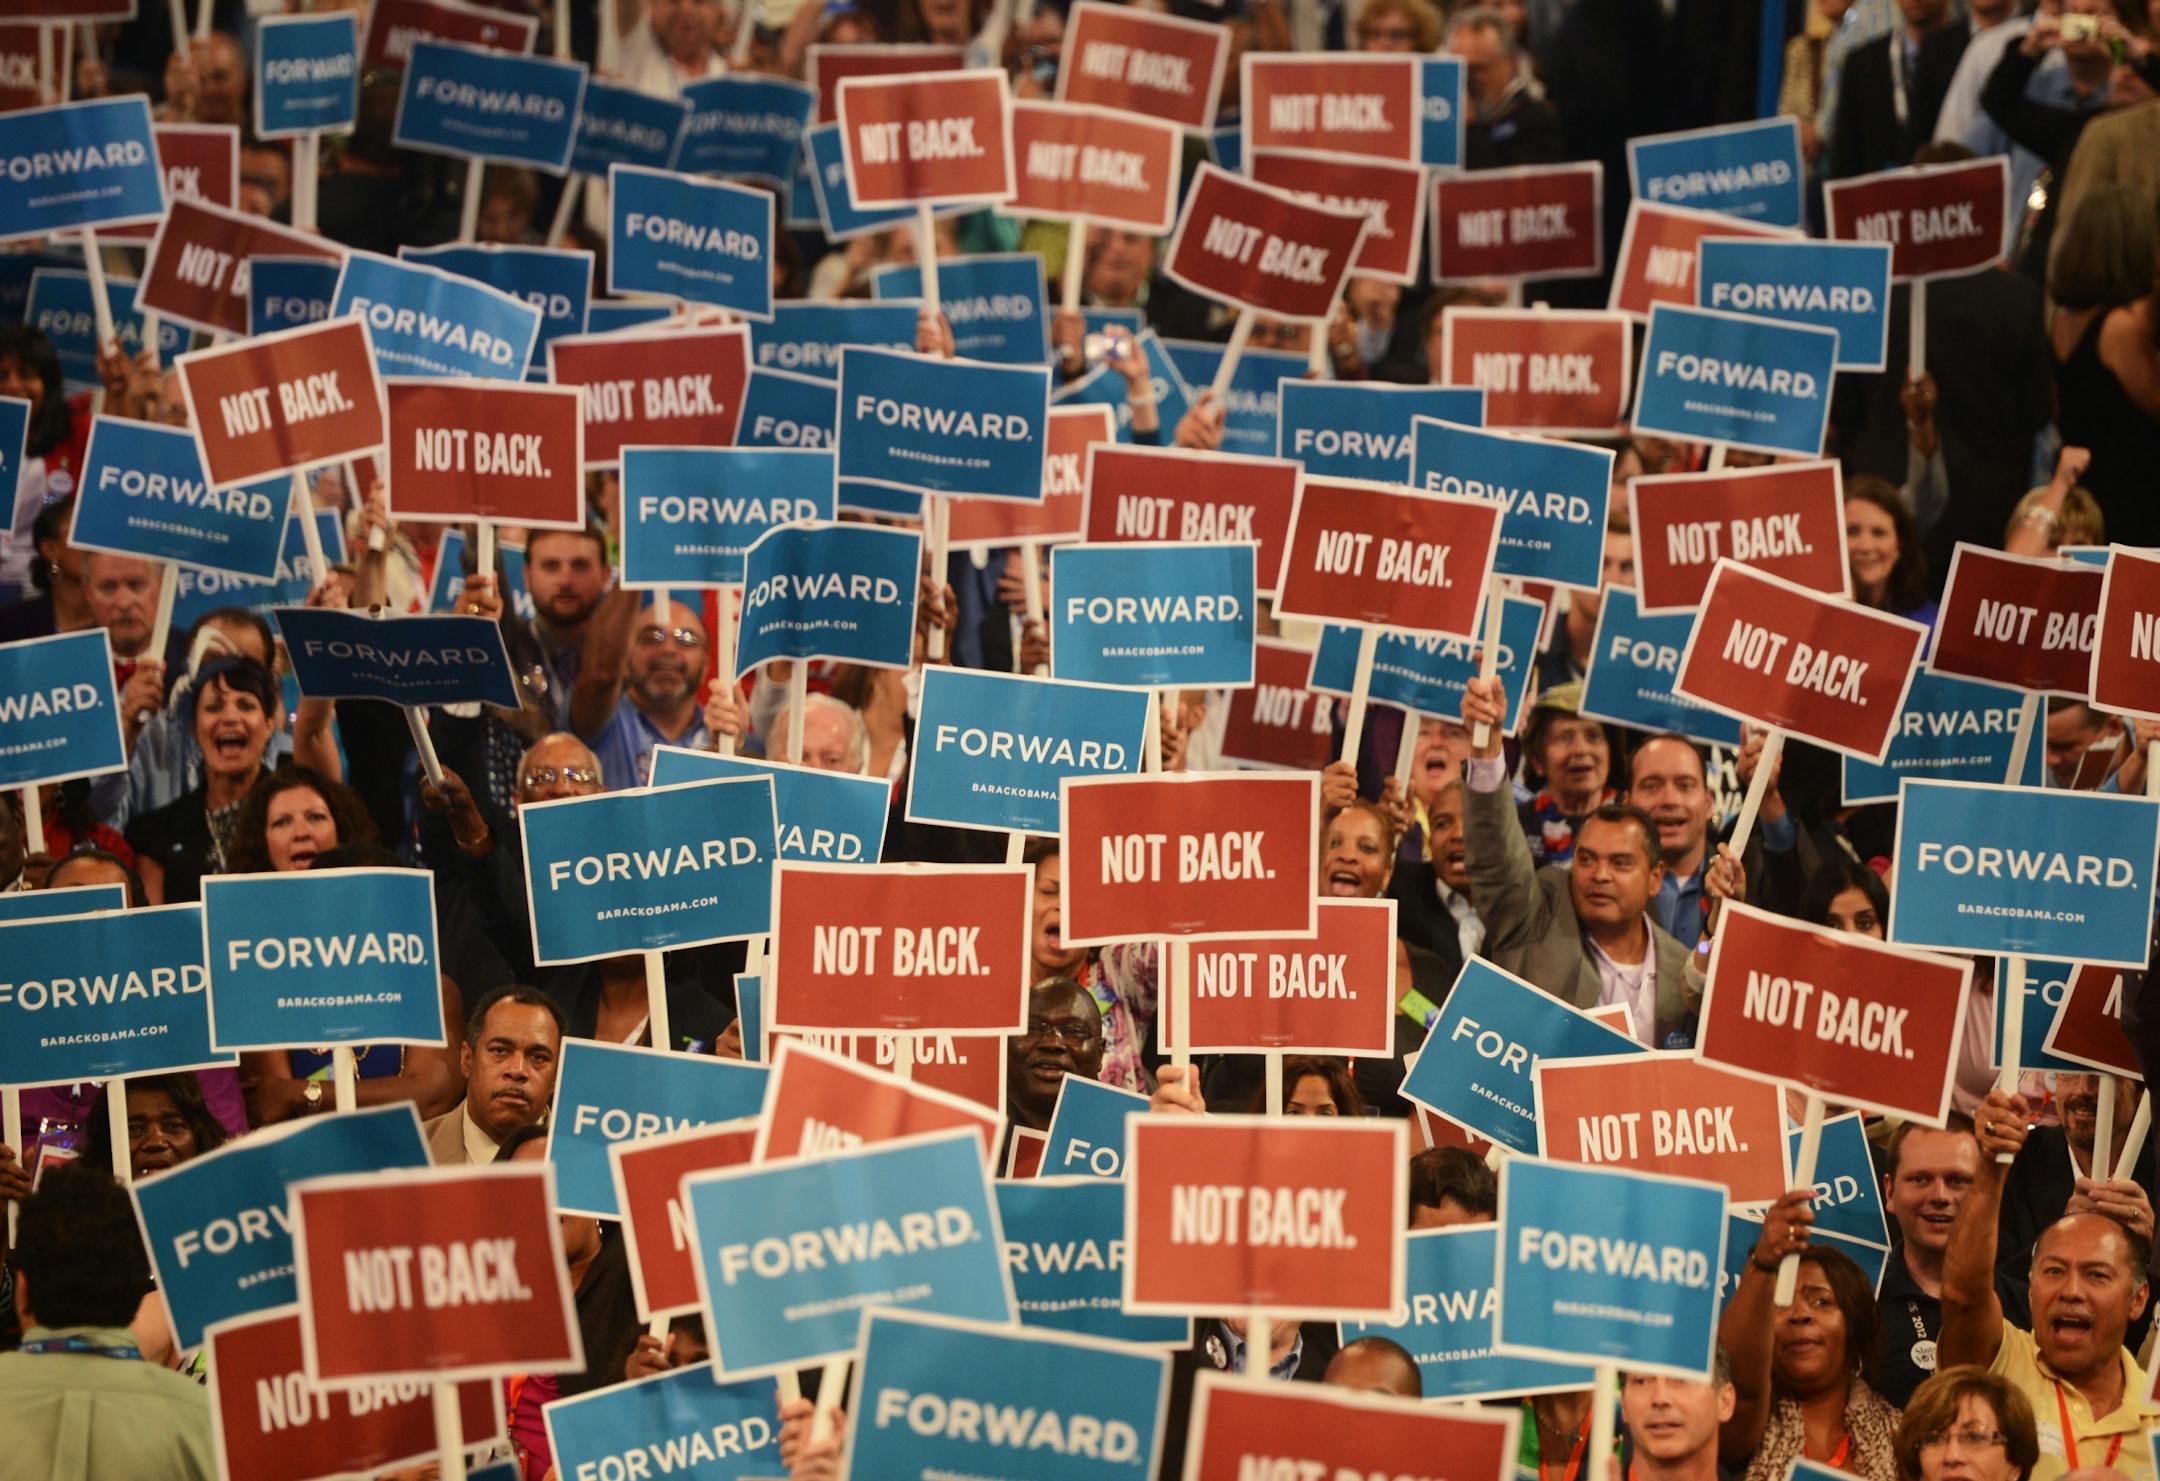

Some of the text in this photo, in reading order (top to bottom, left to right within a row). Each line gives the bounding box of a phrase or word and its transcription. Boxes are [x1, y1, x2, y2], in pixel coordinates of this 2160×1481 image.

[1081, 40, 1193, 95] NOT BACK.
[1269, 94, 1318, 132] NOT
[1321, 94, 1393, 133] BACK.
[859, 116, 985, 165] NOT BACK.
[1027, 141, 1151, 191] NOT BACK.
[1458, 203, 1575, 248] NOT BACK.
[1856, 202, 1983, 244] NOT BACK.
[1203, 215, 1329, 285] NOT BACK.
[1645, 244, 1695, 289] NOT
[1712, 282, 1877, 314] FORWARD.
[352, 297, 514, 369] FORWARD.
[1473, 352, 1600, 394] NOT BACK.
[1656, 350, 1818, 400] FORWARD.
[220, 370, 354, 439] NOT BACK.
[584, 374, 724, 423] NOT BACK.
[856, 394, 1033, 443] FORWARD.
[415, 427, 552, 479] NOT BACK.
[99, 466, 275, 523] FORWARD.
[1116, 495, 1262, 548] NOT BACK.
[1667, 512, 1813, 566] NOT BACK.
[1314, 530, 1453, 589] NOT BACK.
[746, 572, 902, 617] FORWARD.
[1067, 594, 1244, 625] FORWARD.
[1973, 598, 2039, 646] NOT
[303, 639, 495, 668] FORWARD.
[1102, 645, 1205, 658] BARACKOBAMA.COM
[1722, 619, 1869, 707] NOT BACK.
[1253, 683, 1310, 730] NOT
[935, 724, 1128, 772] FORWARD.
[549, 836, 763, 891] FORWARD.
[1100, 830, 1276, 885] NOT BACK.
[1916, 841, 2138, 890] FORWARD.
[596, 896, 719, 921] BARACKOBAMA.COM
[1957, 903, 2086, 923] BARACKOBAMA.COM
[228, 932, 429, 972] FORWARD.
[813, 925, 990, 977] NOT BACK.
[1197, 952, 1357, 1000] NOT BACK.
[277, 992, 402, 1010] BARACKOBAMA.COM
[1742, 970, 1915, 1060] NOT BACK.
[40, 1024, 169, 1048] BARACKOBAMA.COM
[1578, 1105, 1749, 1164] NOT BACK.
[1171, 1184, 1358, 1250] NOT BACK.
[718, 1206, 982, 1286] FORWARD.
[1518, 1225, 1711, 1290] FORWARD.
[343, 1236, 533, 1314] NOT BACK.
[876, 1387, 1143, 1466] FORWARD.
